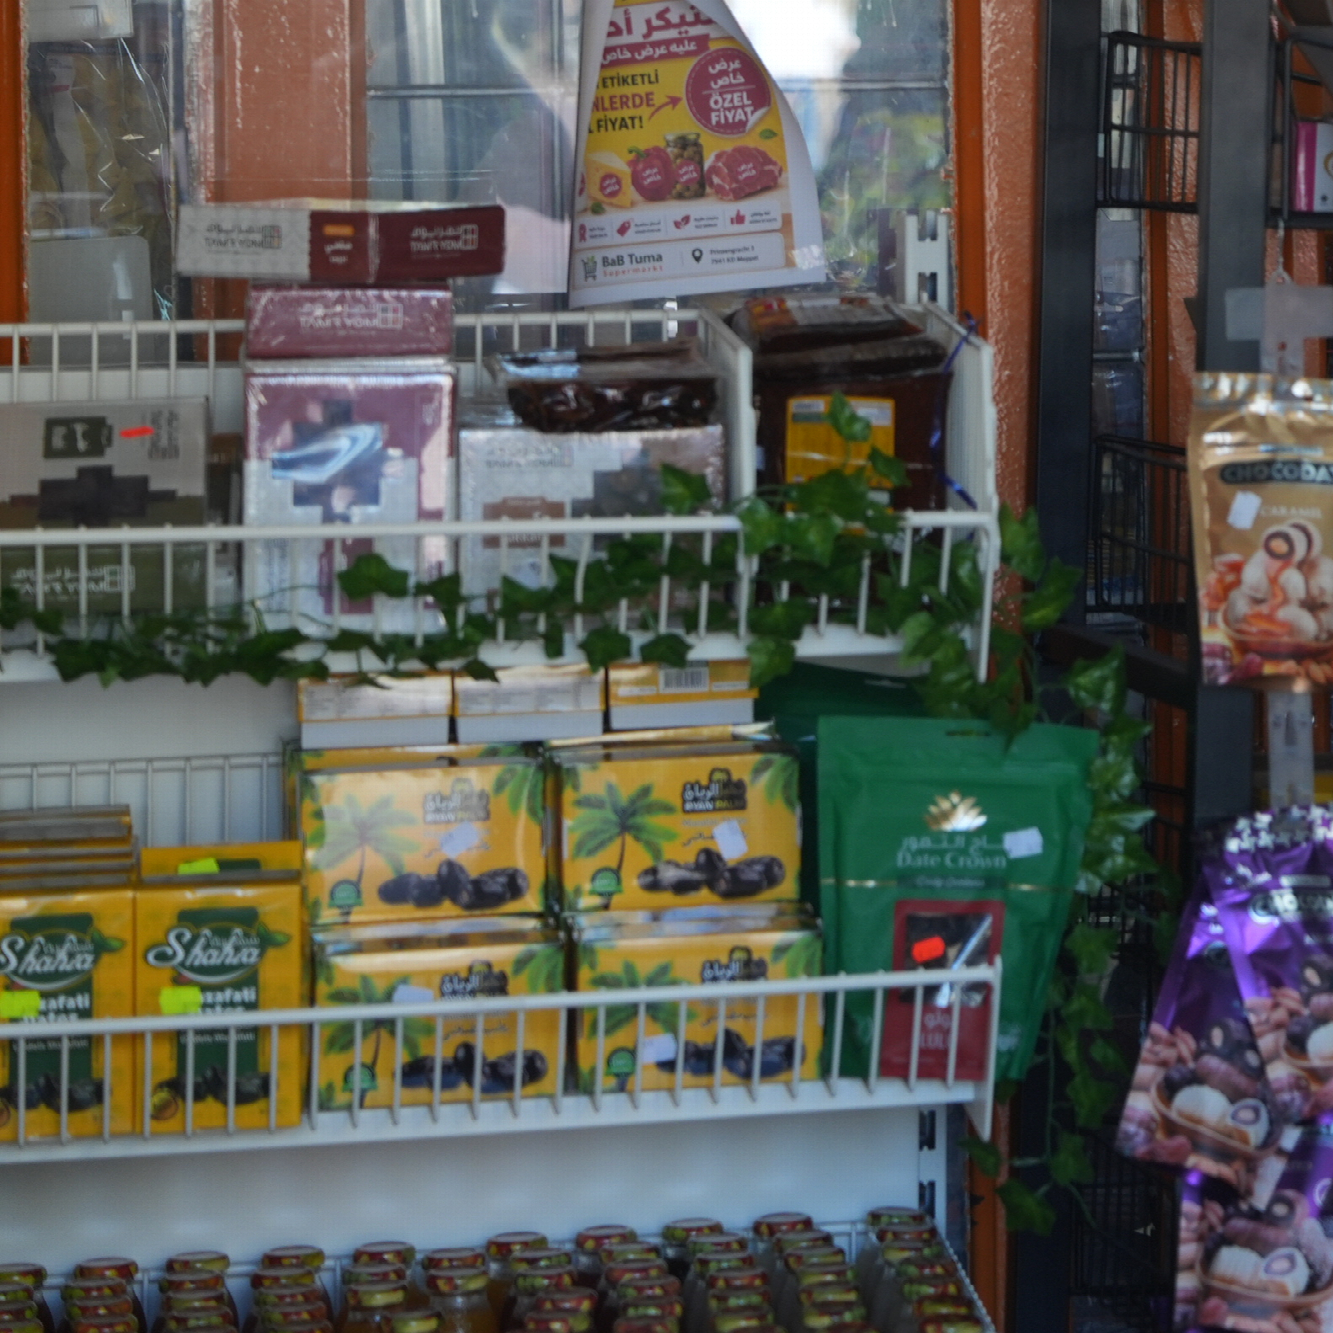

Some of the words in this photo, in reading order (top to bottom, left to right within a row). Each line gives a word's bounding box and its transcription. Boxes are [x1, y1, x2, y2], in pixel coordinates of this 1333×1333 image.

[602, 69, 660, 88] ETİKETLİ
[709, 91, 752, 109] ÖZEL
[597, 115, 644, 133] FİYAT!
[711, 106, 754, 126] FİYAT
[602, 254, 625, 268] BaB
[628, 252, 663, 265] Tuma
[897, 852, 941, 869] Date
[945, 852, 1008, 870] Crown
